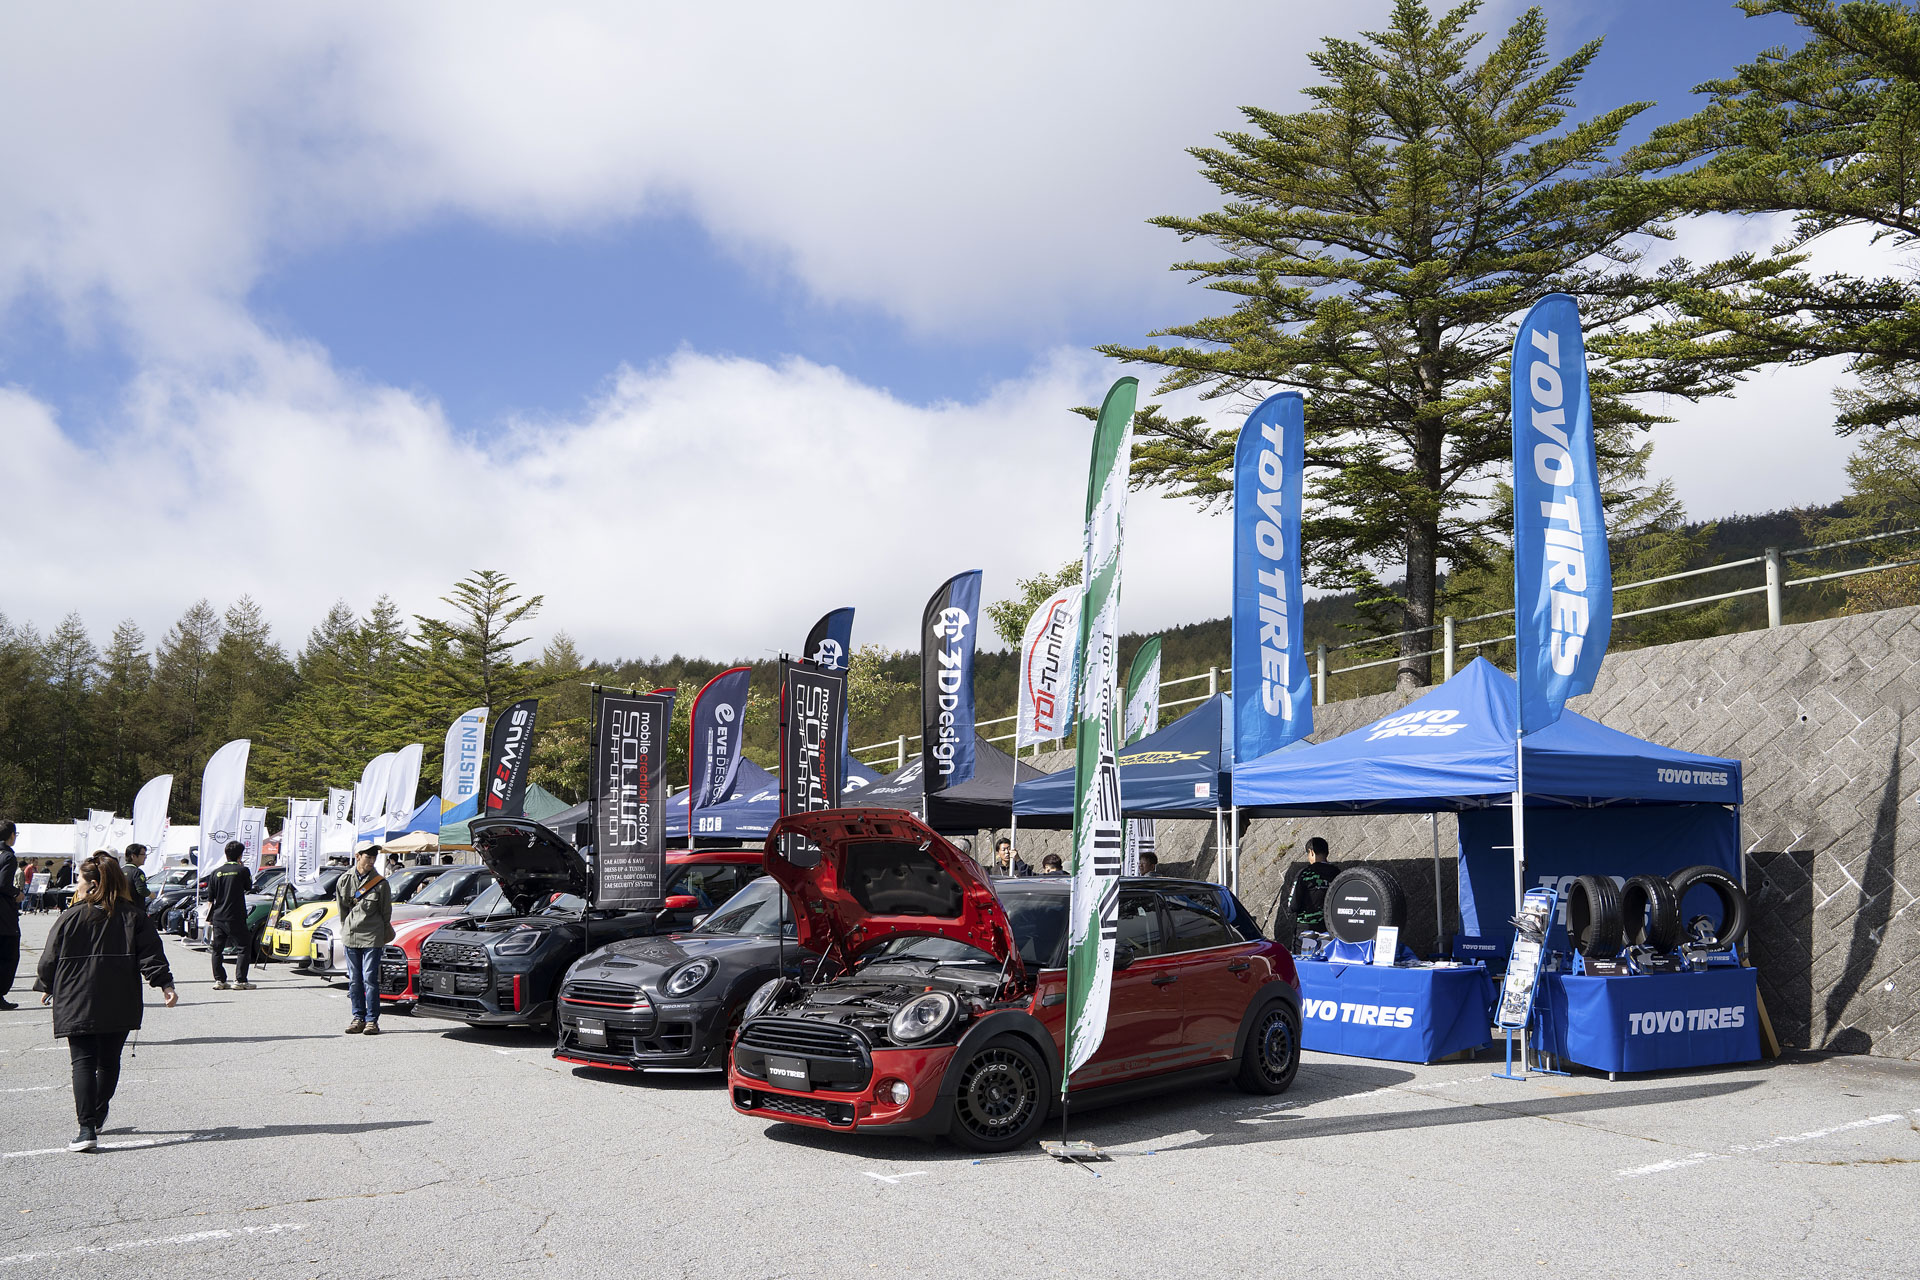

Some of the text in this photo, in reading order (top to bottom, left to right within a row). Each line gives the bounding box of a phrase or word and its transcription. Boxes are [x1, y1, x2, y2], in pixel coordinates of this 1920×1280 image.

[1530, 328, 1590, 676] TOYO TIRES
[1255, 423, 1292, 721] TOYO TIRES
[1102, 632, 1112, 668] For
[1364, 723, 1468, 742] TIRES
[1369, 710, 1460, 732] TOYO
[492, 710, 528, 798] REMUS
[716, 726, 728, 755] EVE
[458, 727, 478, 795] BILSTEIN
[506, 712, 536, 800] PERFORMANCE SPORT EXHAUSTS
[609, 710, 622, 847] CORPORATION
[1657, 768, 1728, 786] TOYO TIRES
[1701, 873, 1728, 881] COUNTRY
[1340, 1002, 1415, 1028] TIRES
[1629, 1005, 1745, 1035] TOYO TIRES
[590, 1028, 604, 1036] TIRES
[769, 1067, 806, 1079] TOYO TIRES
[969, 1067, 989, 1093] RACING
[1007, 1095, 1025, 1121] RACING
